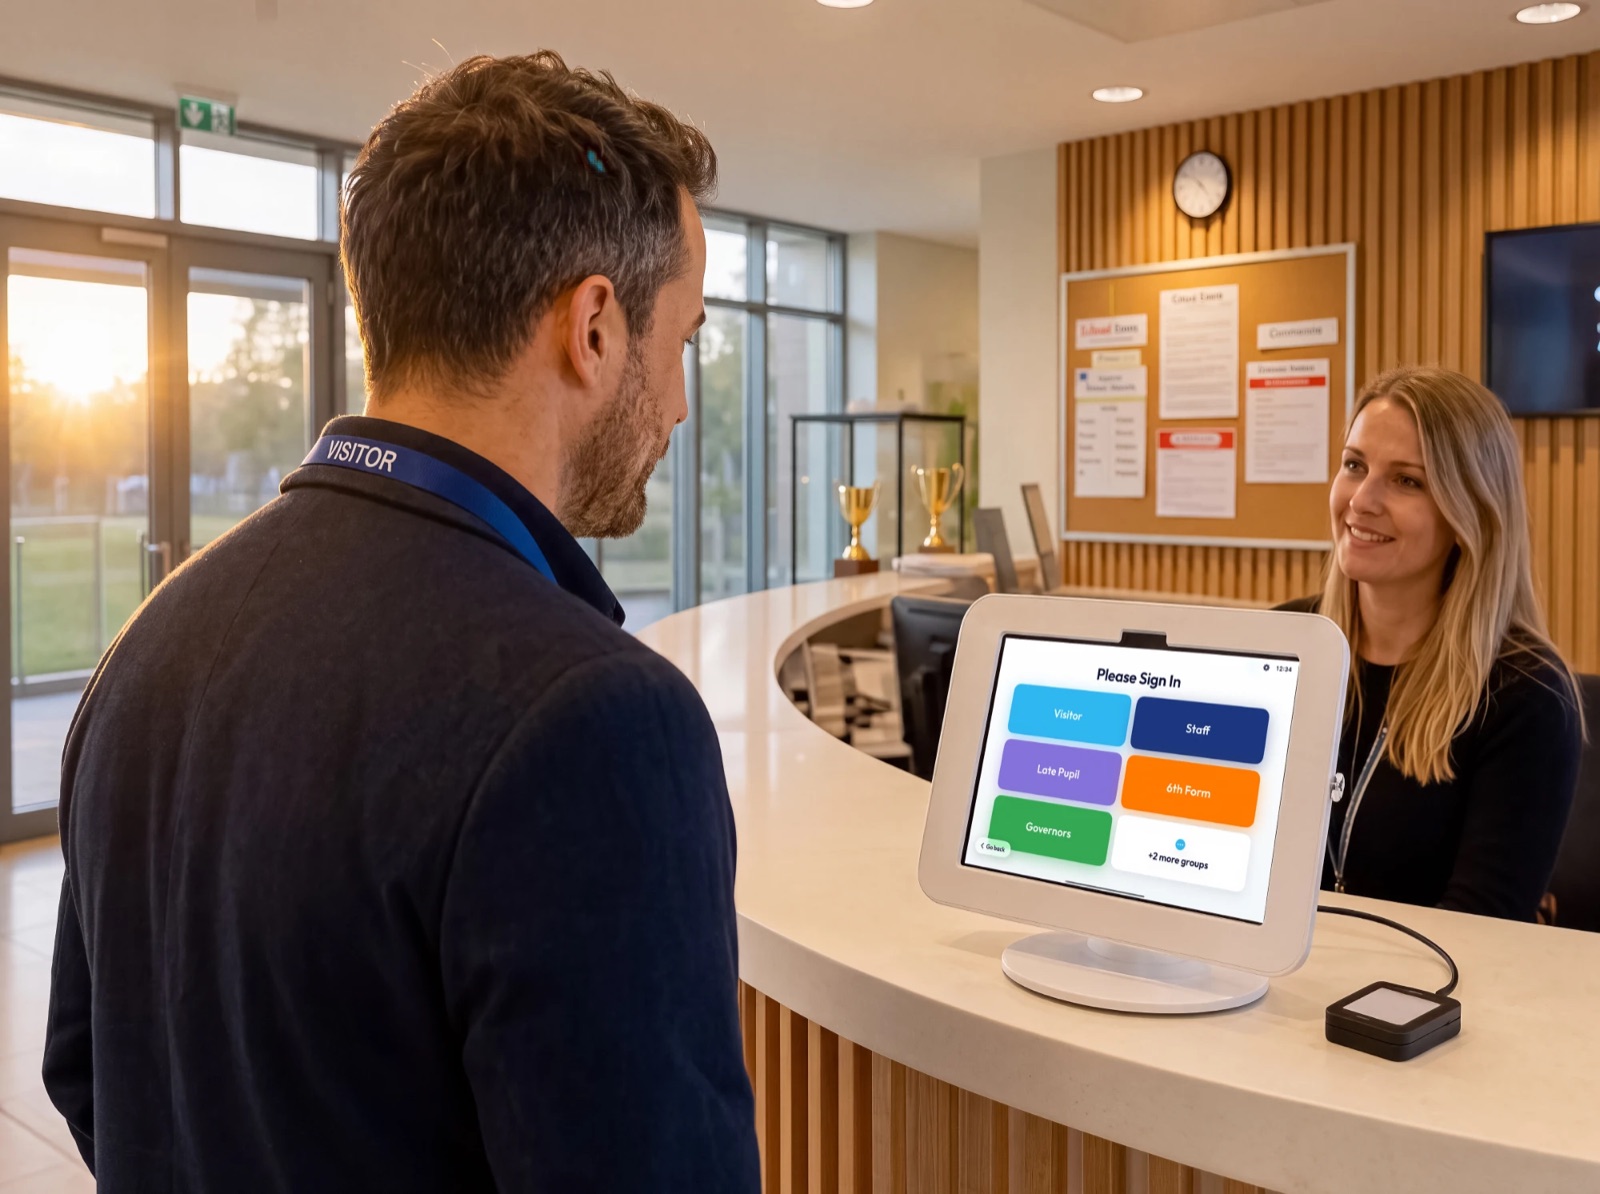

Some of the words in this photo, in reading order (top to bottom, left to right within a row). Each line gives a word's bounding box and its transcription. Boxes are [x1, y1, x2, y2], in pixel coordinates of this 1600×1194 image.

[327, 440, 397, 473] VISITOR
[1276, 665, 1292, 673] 12:34
[1096, 668, 1137, 684] Please
[1139, 672, 1166, 689] Sign
[1169, 675, 1181, 688] In
[1054, 708, 1083, 721] Visitor
[1185, 723, 1211, 736] Staff
[1037, 764, 1057, 776] Late
[1058, 767, 1080, 781] Pupil
[1166, 782, 1183, 794] 6th
[1184, 785, 1211, 799] Form
[1025, 822, 1071, 839] Governors
[1148, 852, 1158, 861] +2
[1159, 854, 1179, 865] more
[1180, 858, 1209, 870] groups
